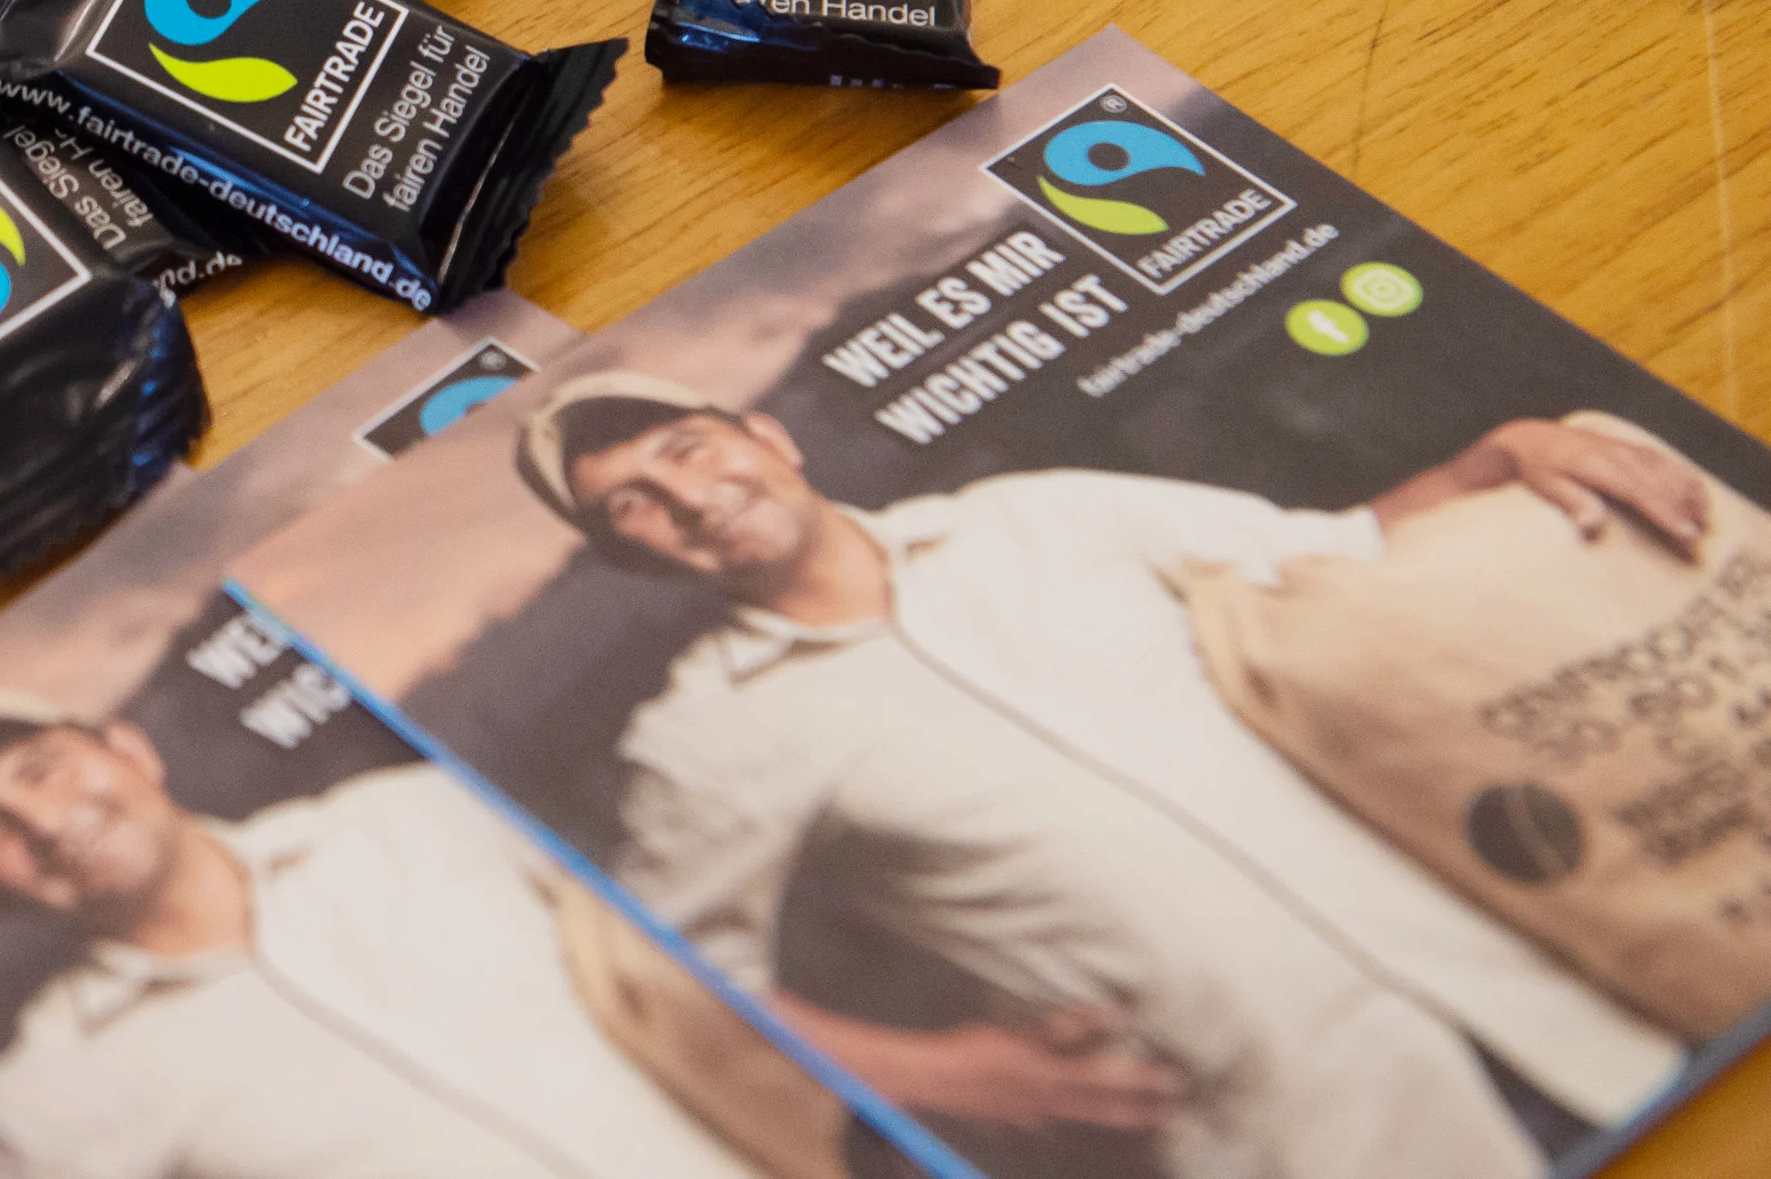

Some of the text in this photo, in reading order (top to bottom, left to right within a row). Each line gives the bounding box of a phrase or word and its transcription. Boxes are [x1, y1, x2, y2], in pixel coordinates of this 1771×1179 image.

[283, 1, 385, 152] FAIRTRADE
[343, 25, 456, 200] Das Siegel für
[383, 49, 491, 213] fairen Handel
[3, 125, 78, 199] Siegel
[75, 196, 126, 250] Das
[89, 159, 153, 227] fairen
[1136, 188, 1272, 279] FAIRTRADE
[822, 231, 1067, 388] WEIL ES MIR
[875, 273, 1129, 445] WICHTIG IST
